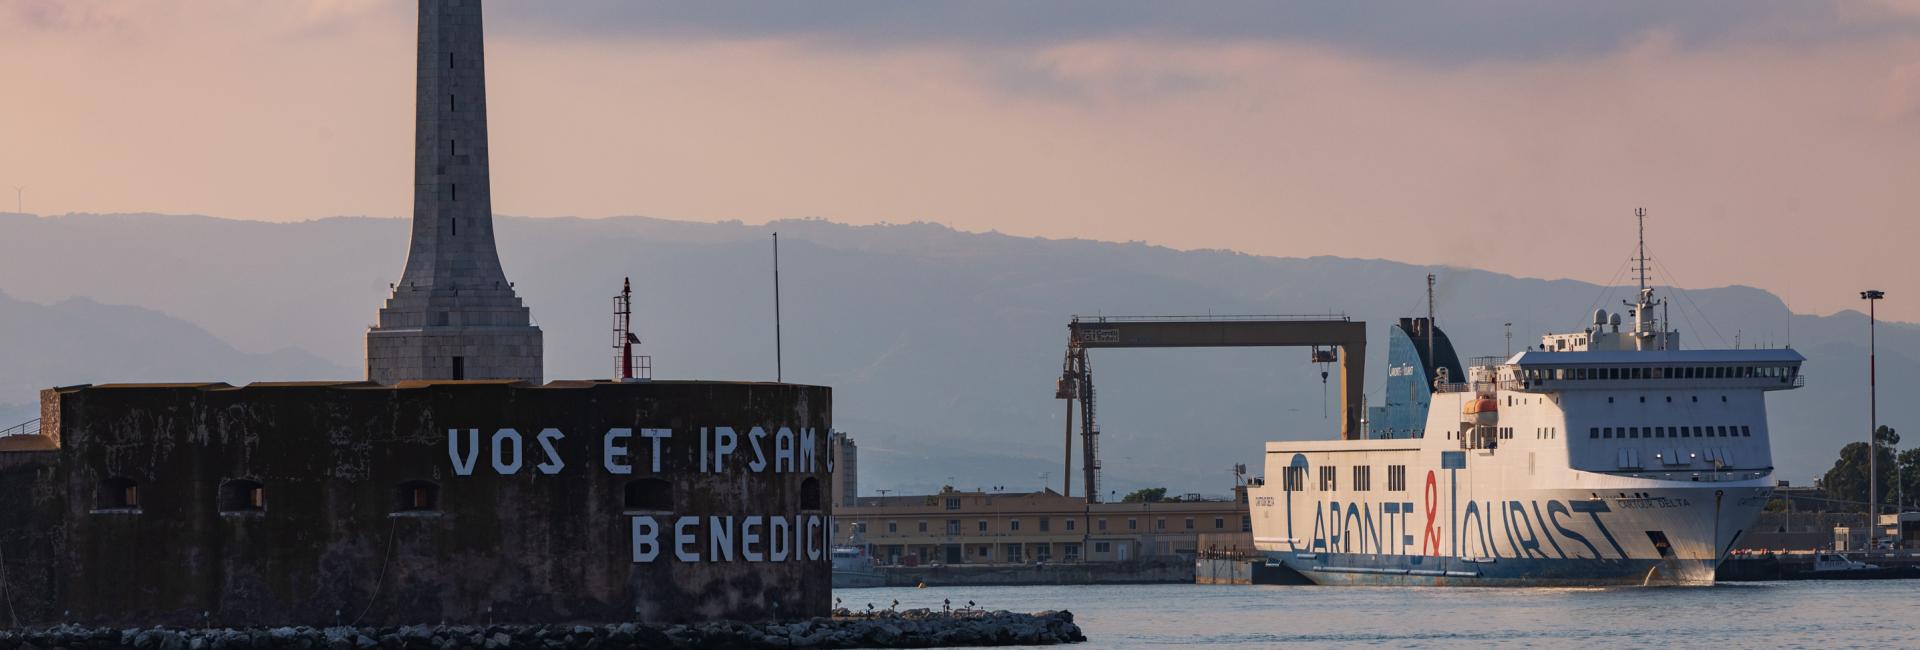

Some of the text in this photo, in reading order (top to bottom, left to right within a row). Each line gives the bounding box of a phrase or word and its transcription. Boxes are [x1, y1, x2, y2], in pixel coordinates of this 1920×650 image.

[448, 427, 565, 476] VOS
[604, 427, 672, 474] ET
[700, 426, 815, 473] IPSAM
[1287, 451, 1630, 559] CARONTE & TOURIST
